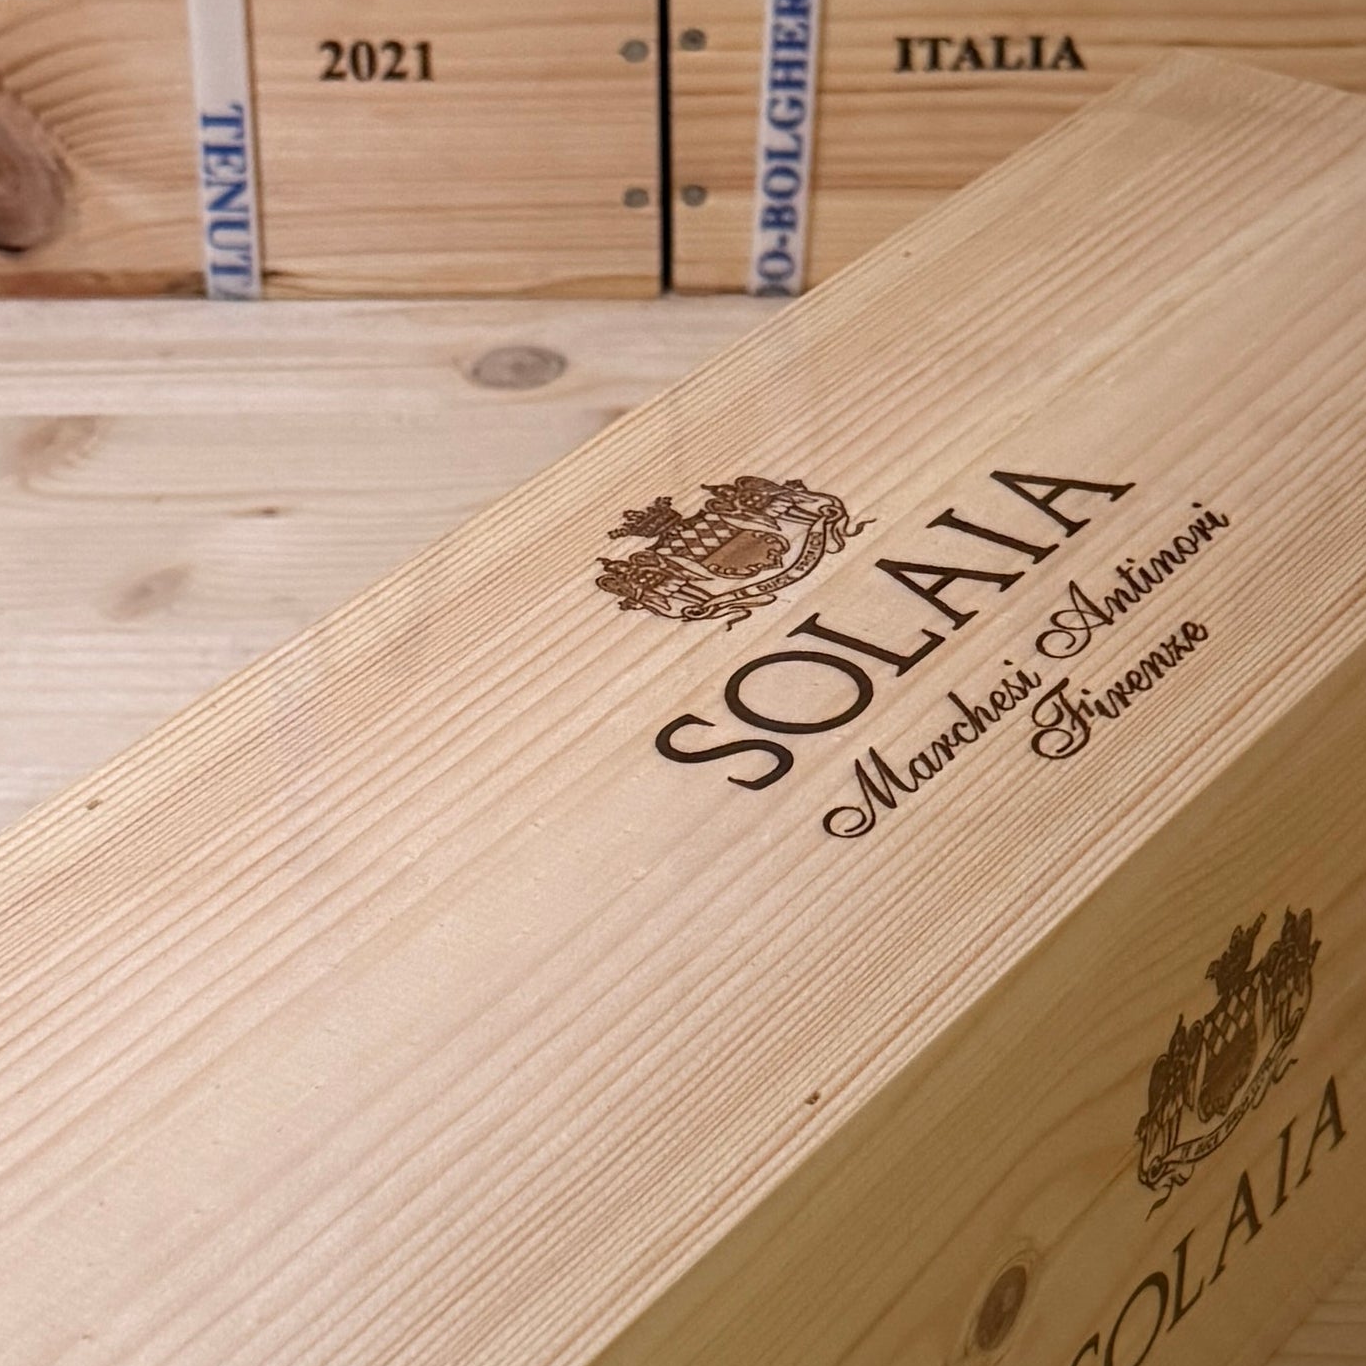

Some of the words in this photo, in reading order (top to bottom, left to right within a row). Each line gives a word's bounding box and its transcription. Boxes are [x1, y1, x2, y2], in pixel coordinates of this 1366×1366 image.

[318, 40, 435, 84] 2021
[894, 35, 1088, 73] ITALIA
[654, 469, 1136, 791] SOLAIA
[822, 659, 1042, 839] Marchesi
[1035, 501, 1231, 660] Antinori
[1031, 620, 1209, 760] Firenze
